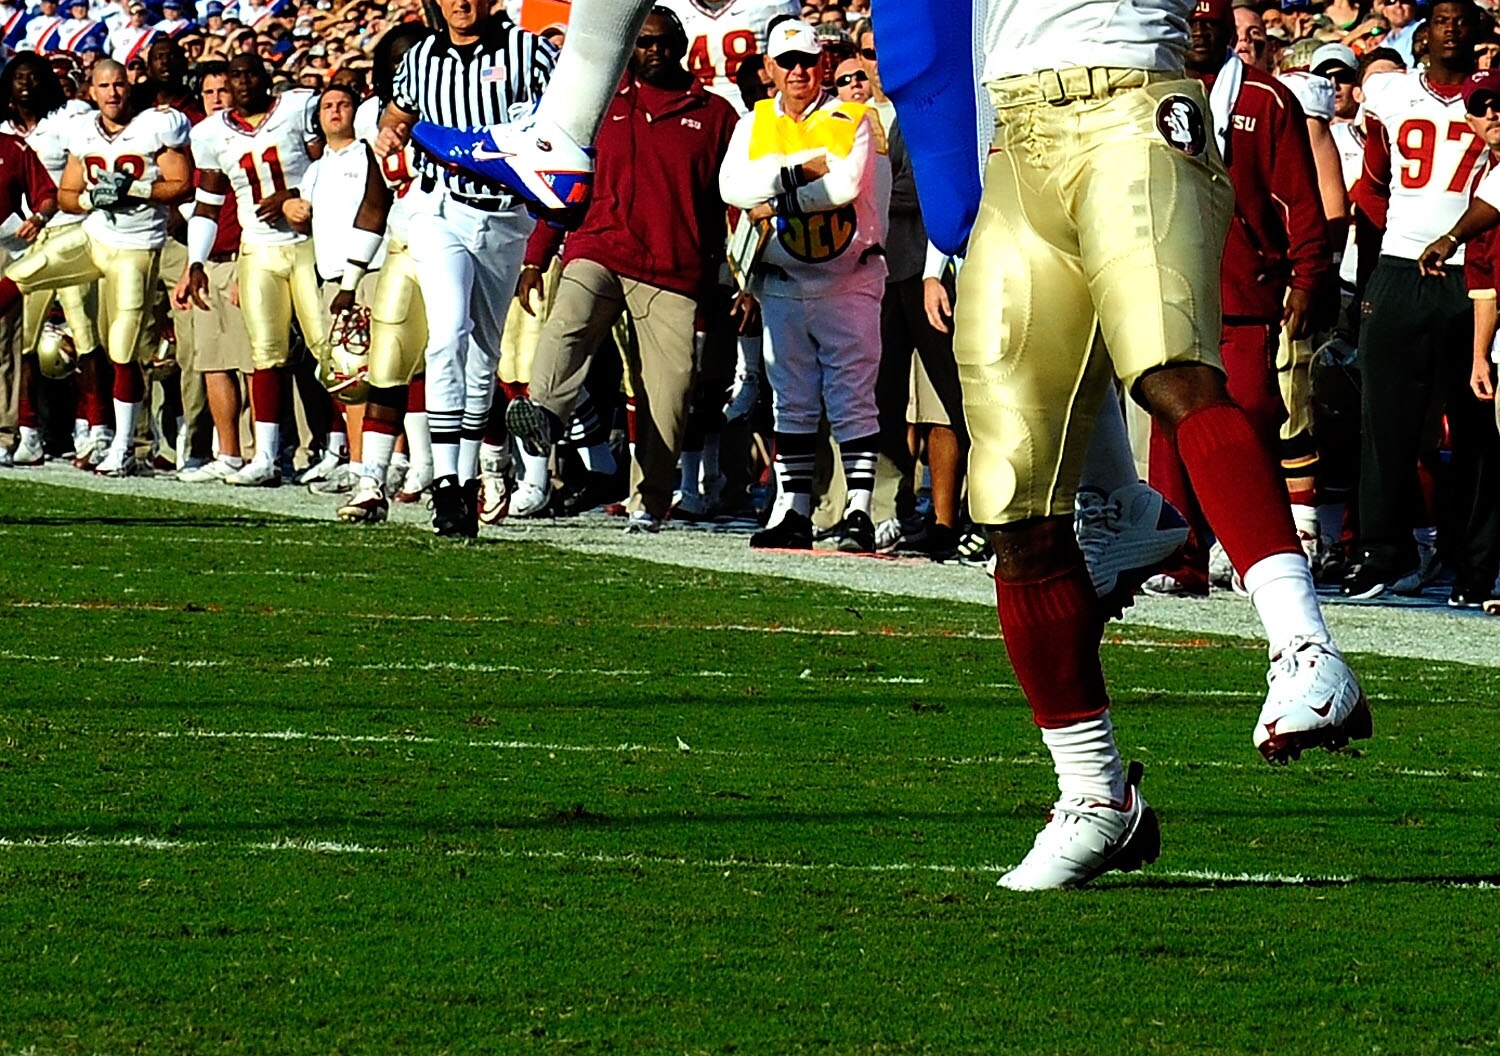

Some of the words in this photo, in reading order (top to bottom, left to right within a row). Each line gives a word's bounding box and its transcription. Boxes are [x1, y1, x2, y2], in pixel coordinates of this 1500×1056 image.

[686, 28, 758, 87] 48
[238, 145, 288, 205] 11
[1396, 117, 1486, 194] 97
